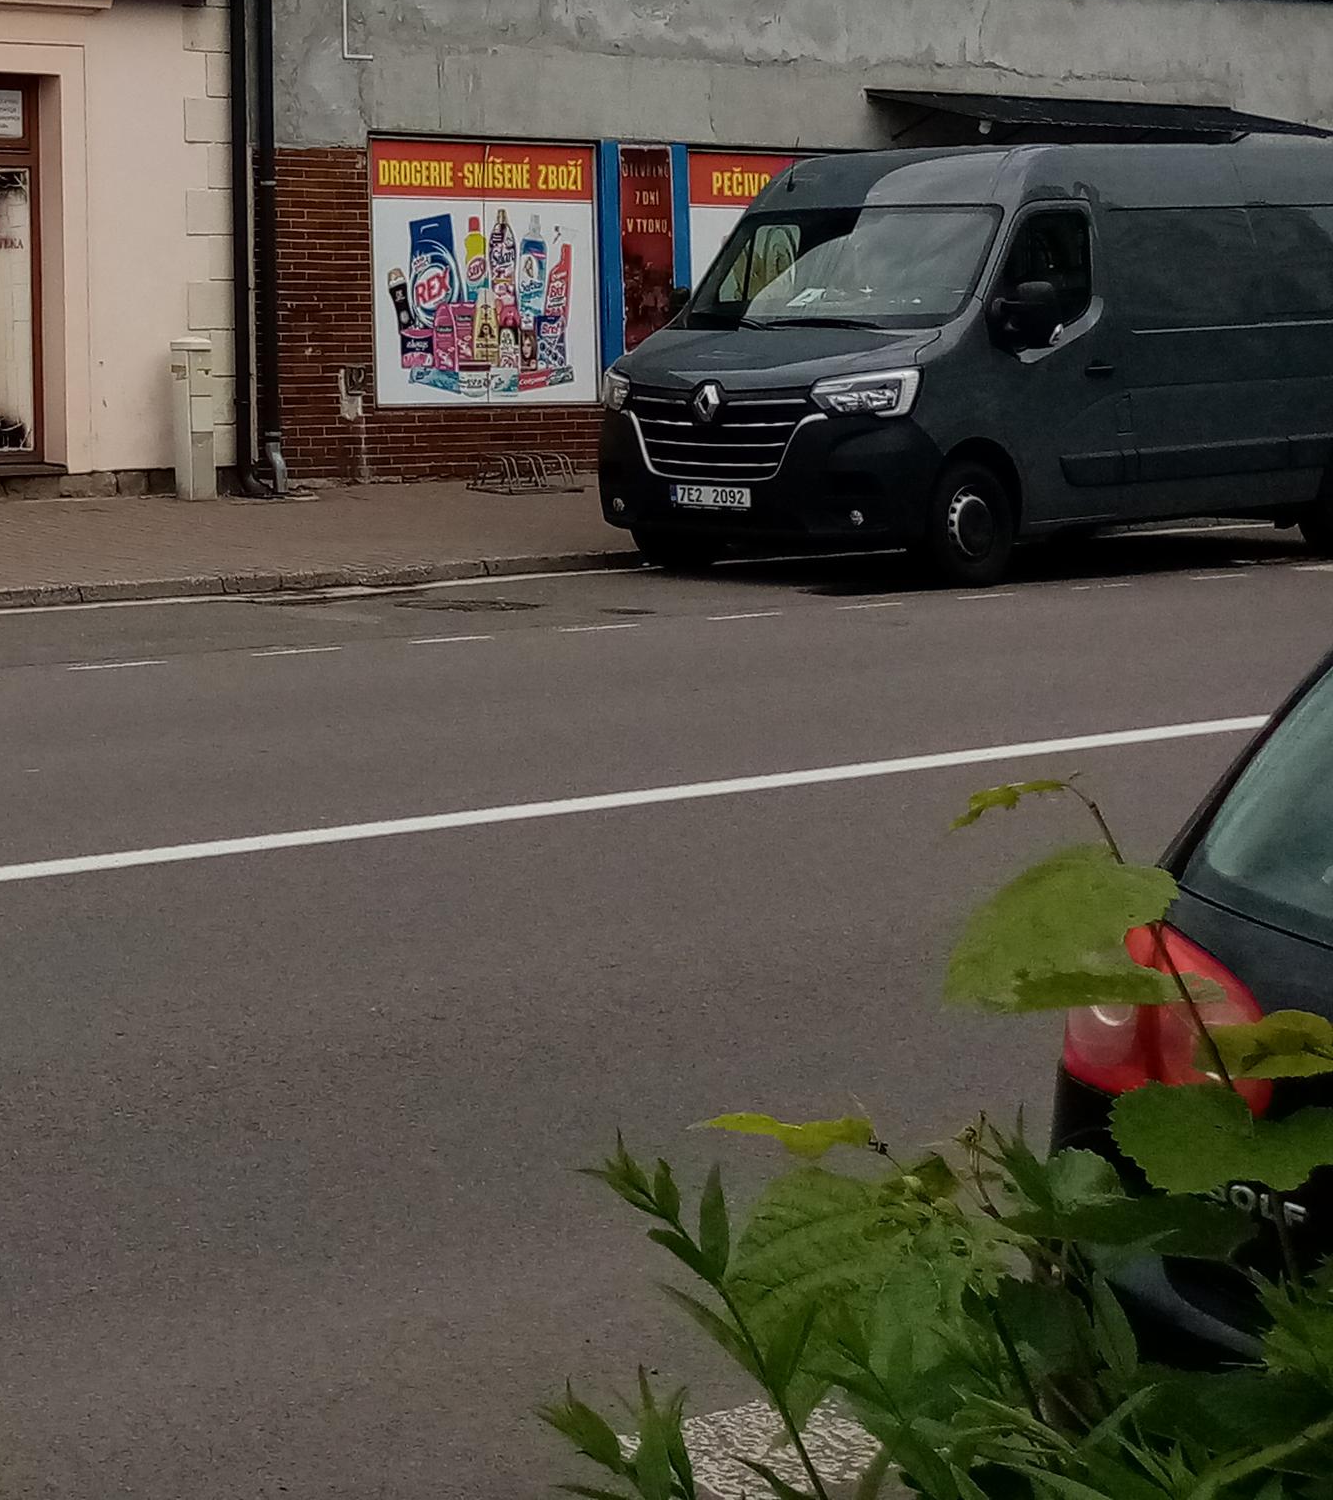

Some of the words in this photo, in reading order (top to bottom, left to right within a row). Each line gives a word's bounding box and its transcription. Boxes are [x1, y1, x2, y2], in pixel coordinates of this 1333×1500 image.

[378, 159, 454, 188] DROGERIE
[538, 159, 583, 191] ZBOŽÍ
[635, 191, 641, 205] 7
[626, 217, 634, 233] V
[415, 265, 451, 307] REX
[679, 486, 703, 503] 7E2
[712, 488, 745, 505] 2092
[1209, 1185, 1308, 1226] OLF
